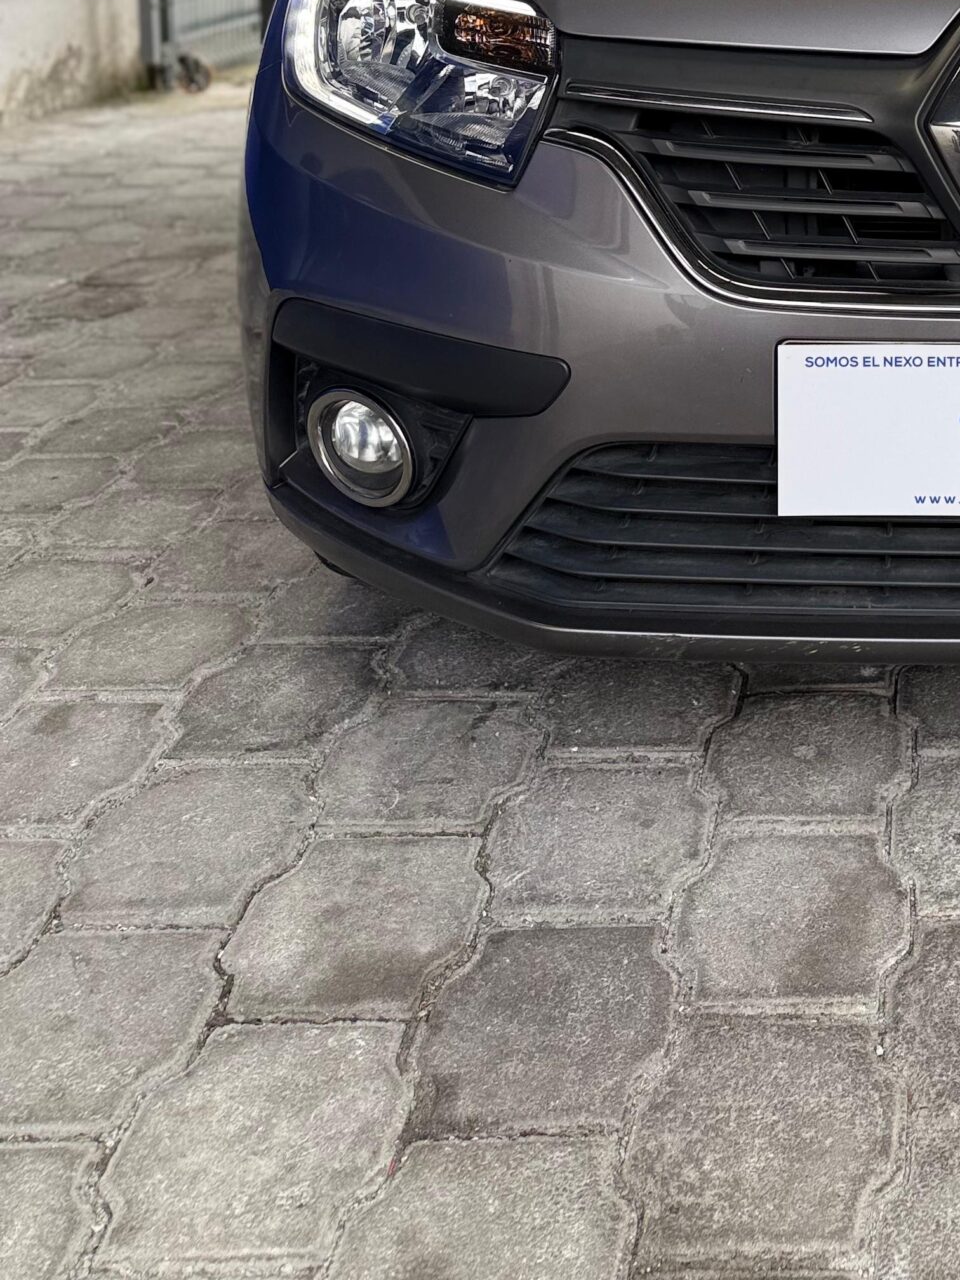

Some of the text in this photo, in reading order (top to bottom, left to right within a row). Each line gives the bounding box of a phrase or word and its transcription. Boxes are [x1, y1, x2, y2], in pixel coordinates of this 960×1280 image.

[804, 356, 859, 368] SOMOS
[862, 356, 881, 368] EL
[883, 356, 924, 368] NEXO
